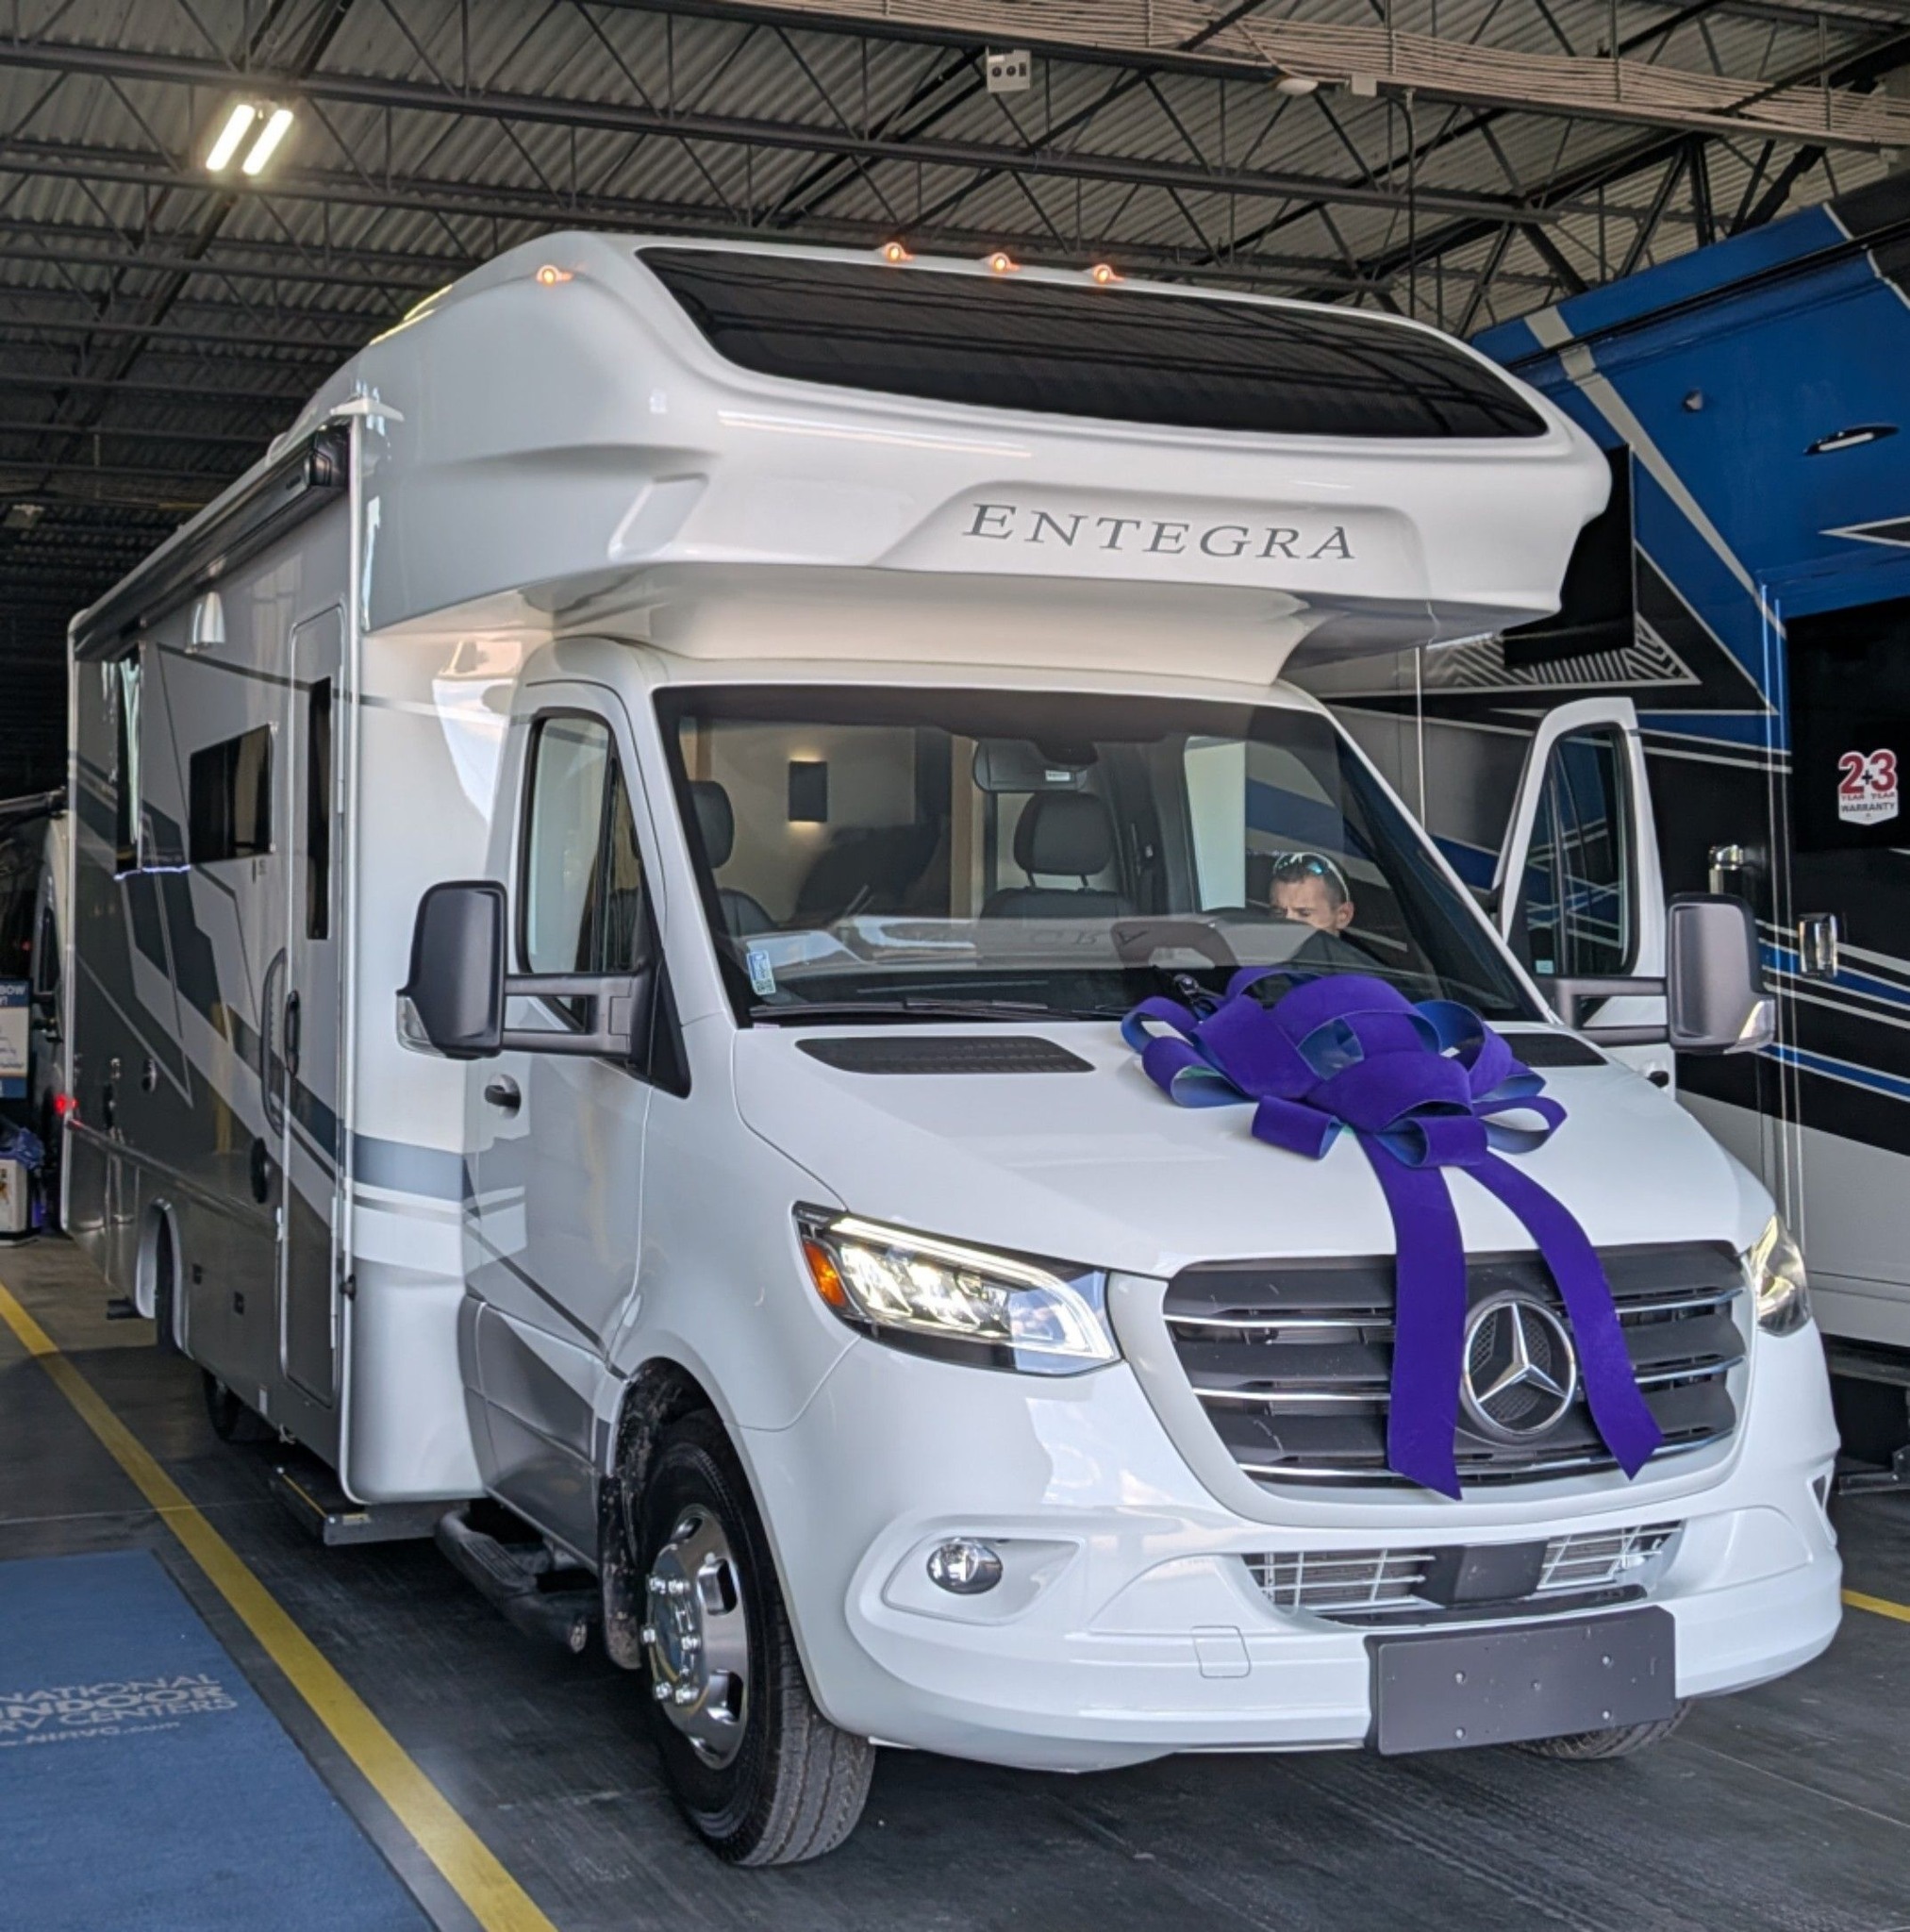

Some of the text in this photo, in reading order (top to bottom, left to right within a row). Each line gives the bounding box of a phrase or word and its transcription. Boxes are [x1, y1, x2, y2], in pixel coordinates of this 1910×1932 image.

[961, 502, 1355, 559] ENTEGRA
[1841, 802, 1895, 812] WARRANTY
[58, 1699, 239, 1726] CENTERS
